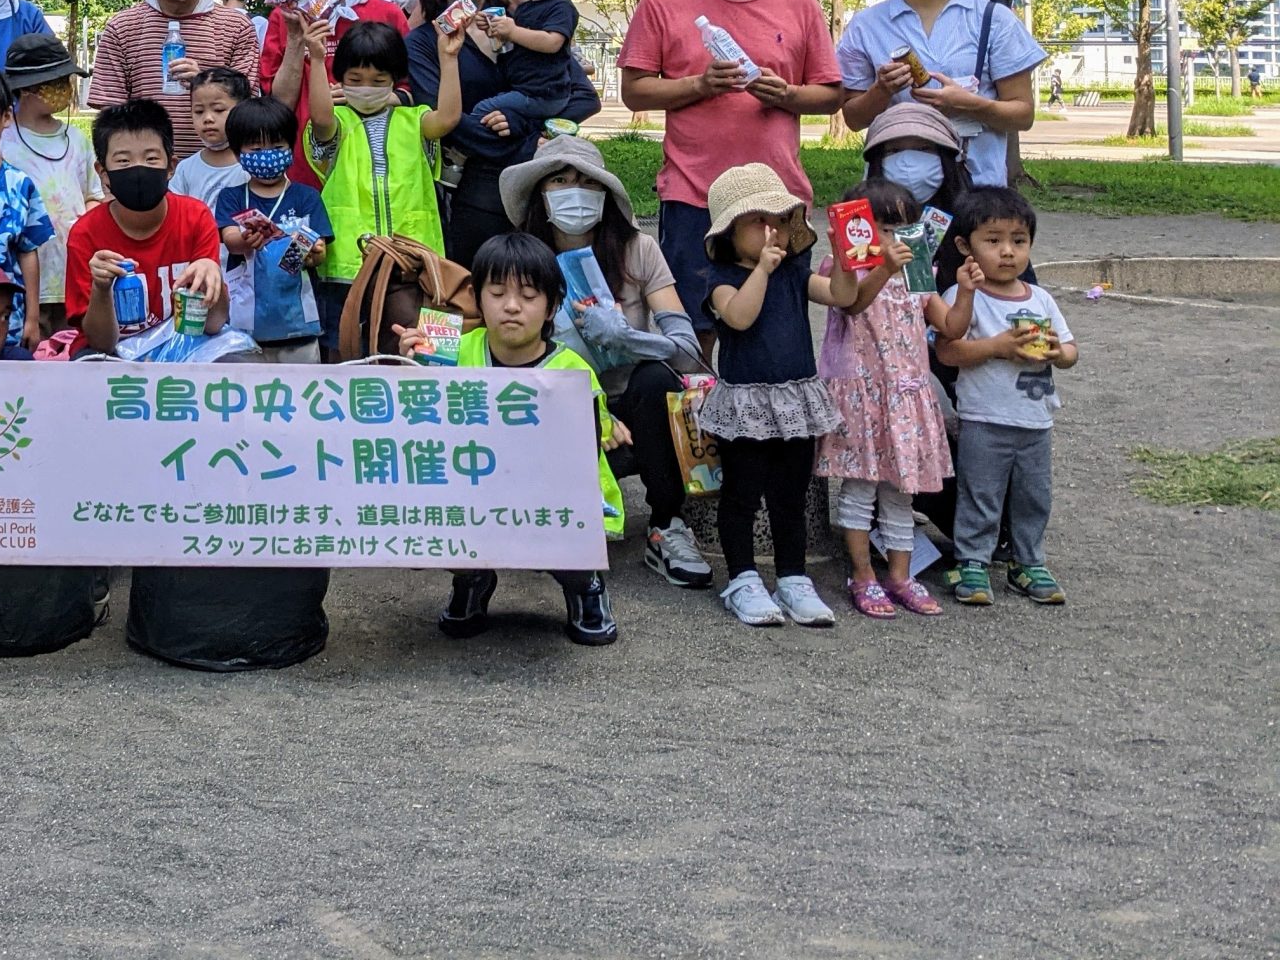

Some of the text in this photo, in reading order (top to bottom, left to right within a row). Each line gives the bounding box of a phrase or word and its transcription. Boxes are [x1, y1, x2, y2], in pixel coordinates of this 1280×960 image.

[848, 226, 871, 239] ビスコ
[425, 325, 459, 337] PRETZ
[106, 375, 541, 427] 高島中央公園愛護会
[160, 437, 497, 486] イベント開催中
[72, 501, 587, 531] どなたでもご参加頂けます、道具は用意しています。
[10, 522, 36, 534] Park
[0, 536, 37, 549] CLUB
[182, 534, 480, 559] スタッフにお声かけください。
